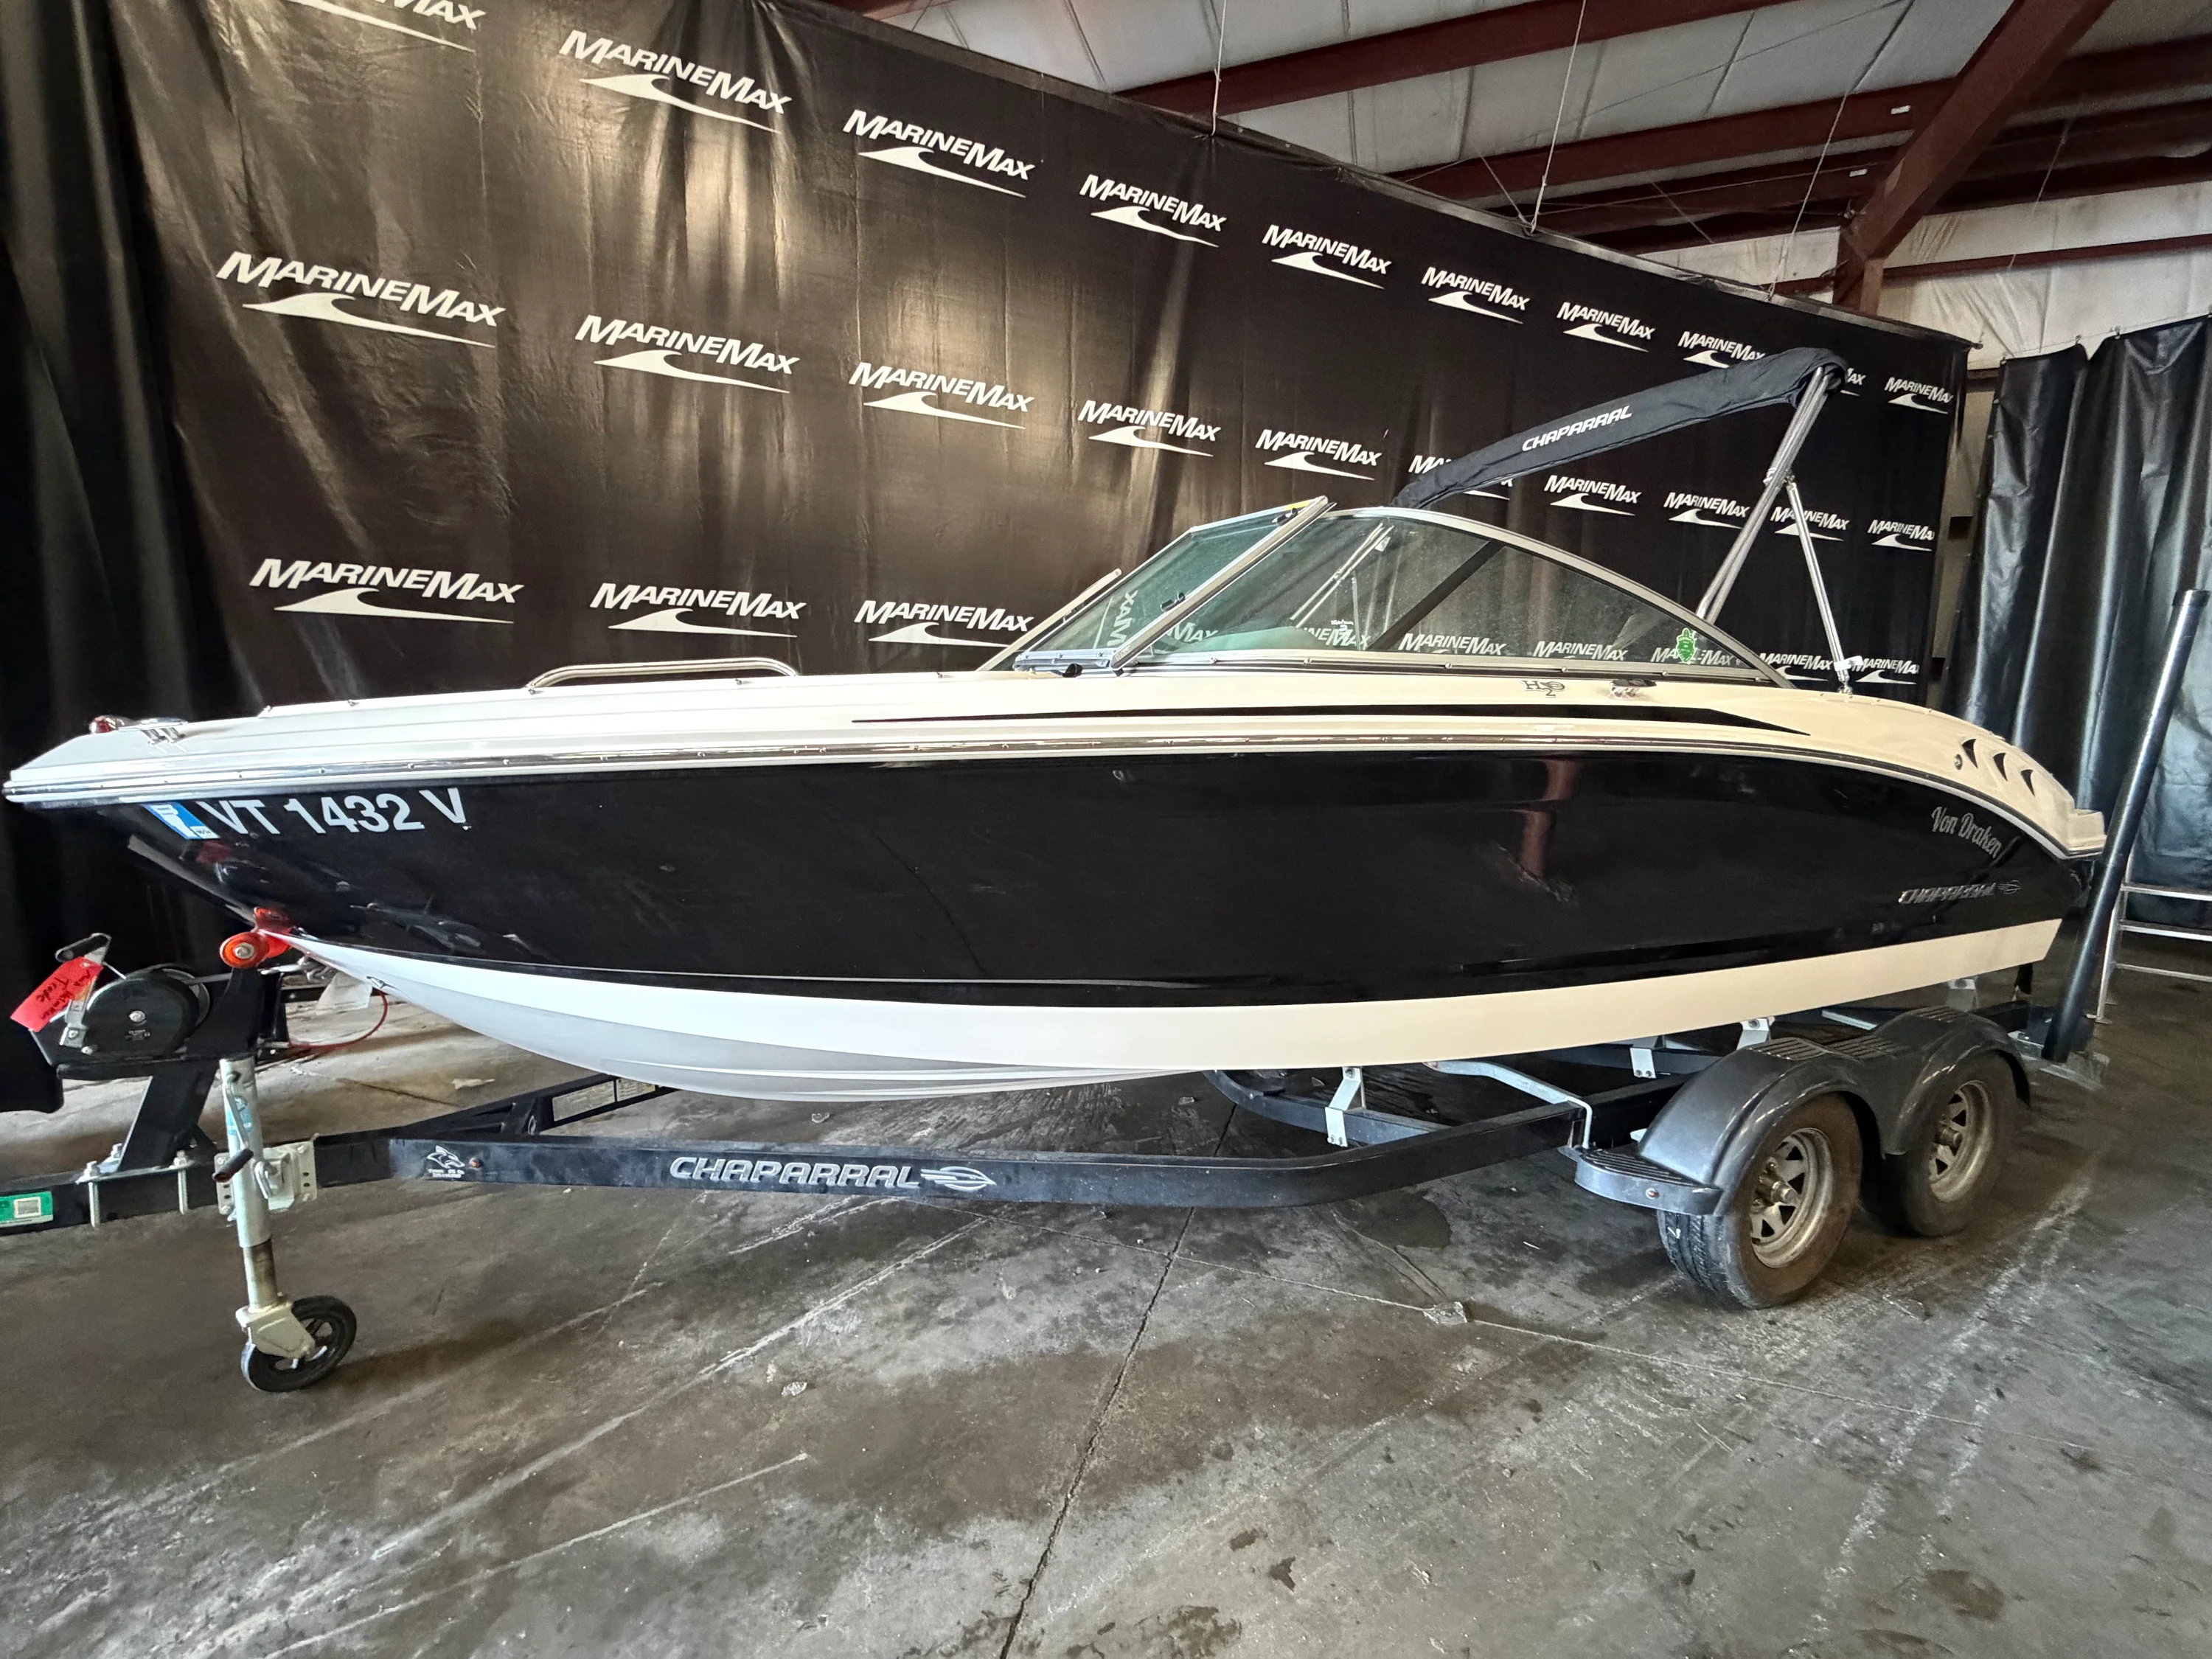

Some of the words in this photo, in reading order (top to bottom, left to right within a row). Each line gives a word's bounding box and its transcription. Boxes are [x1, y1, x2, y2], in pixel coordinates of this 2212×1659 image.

[1522, 406, 1632, 452] CHAPARRAL
[196, 800, 281, 835] VT
[284, 792, 425, 835] 1432
[419, 787, 466, 824] V
[669, 1157, 921, 1188] CHAPARRAL
